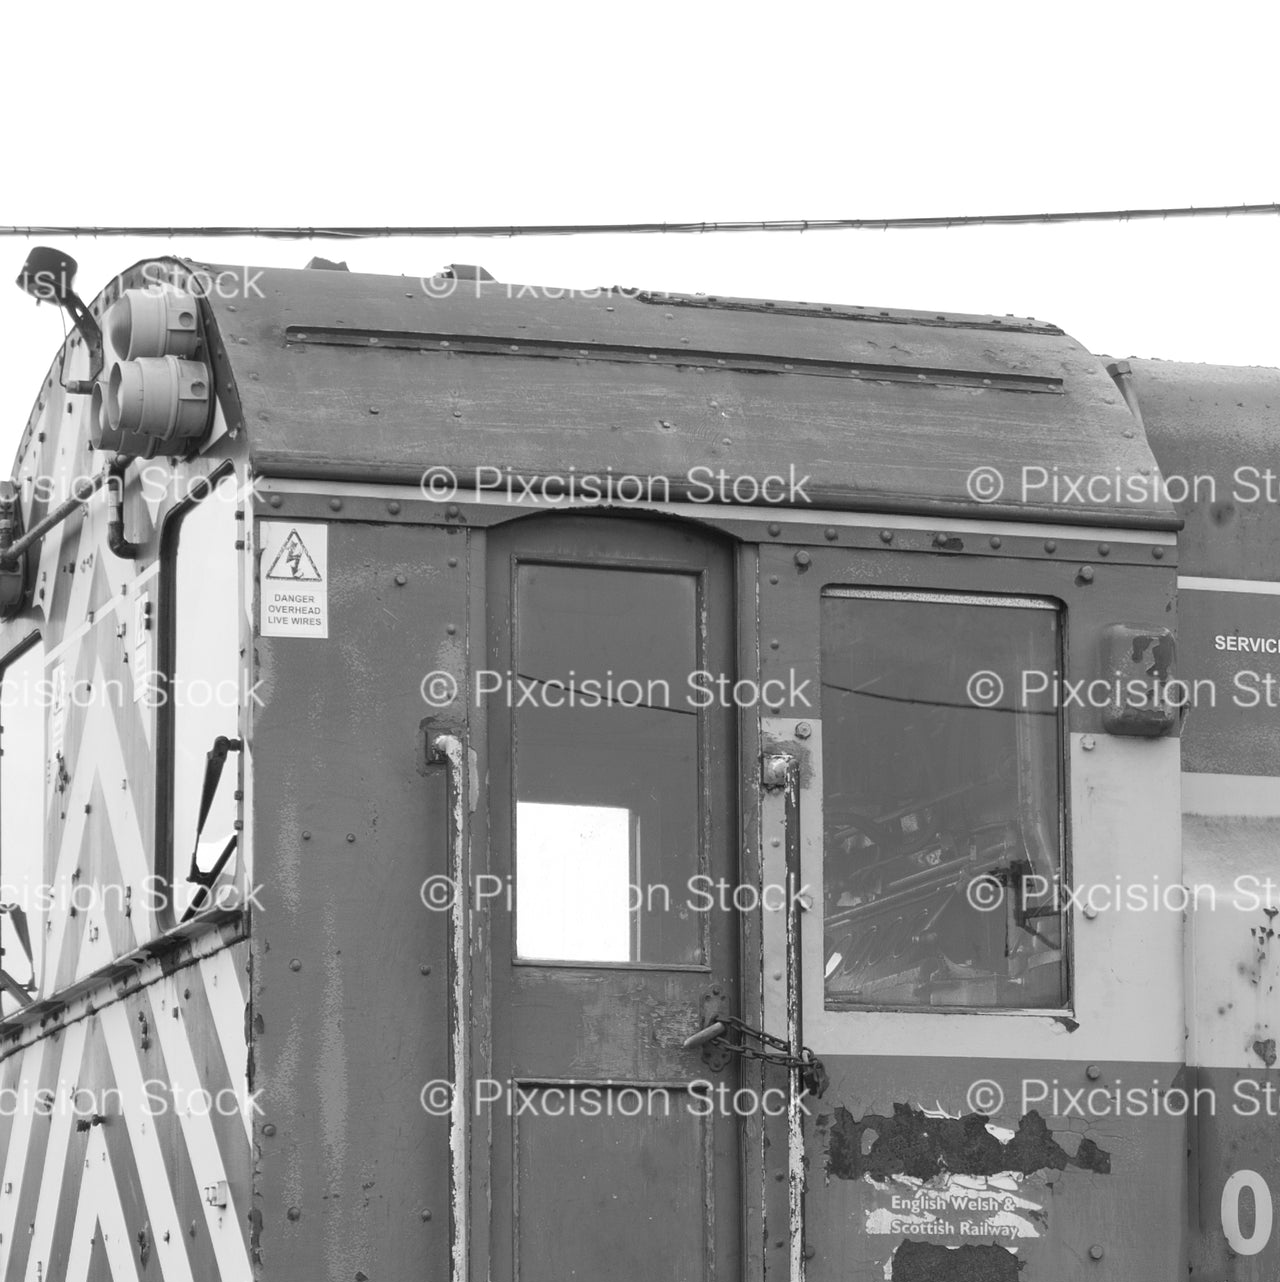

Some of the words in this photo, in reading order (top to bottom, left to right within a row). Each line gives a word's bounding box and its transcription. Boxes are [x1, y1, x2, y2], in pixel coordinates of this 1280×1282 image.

[274, 593, 315, 603] DANGER
[267, 604, 321, 615] OVERHEAD
[267, 616, 289, 625] LIVE
[291, 617, 322, 626] WIRES
[891, 1195, 946, 1214] English
[951, 1196, 998, 1211] Welsh
[1003, 1196, 1016, 1212] &
[891, 1220, 955, 1236] Scottish
[960, 1221, 1019, 1240] Railway
